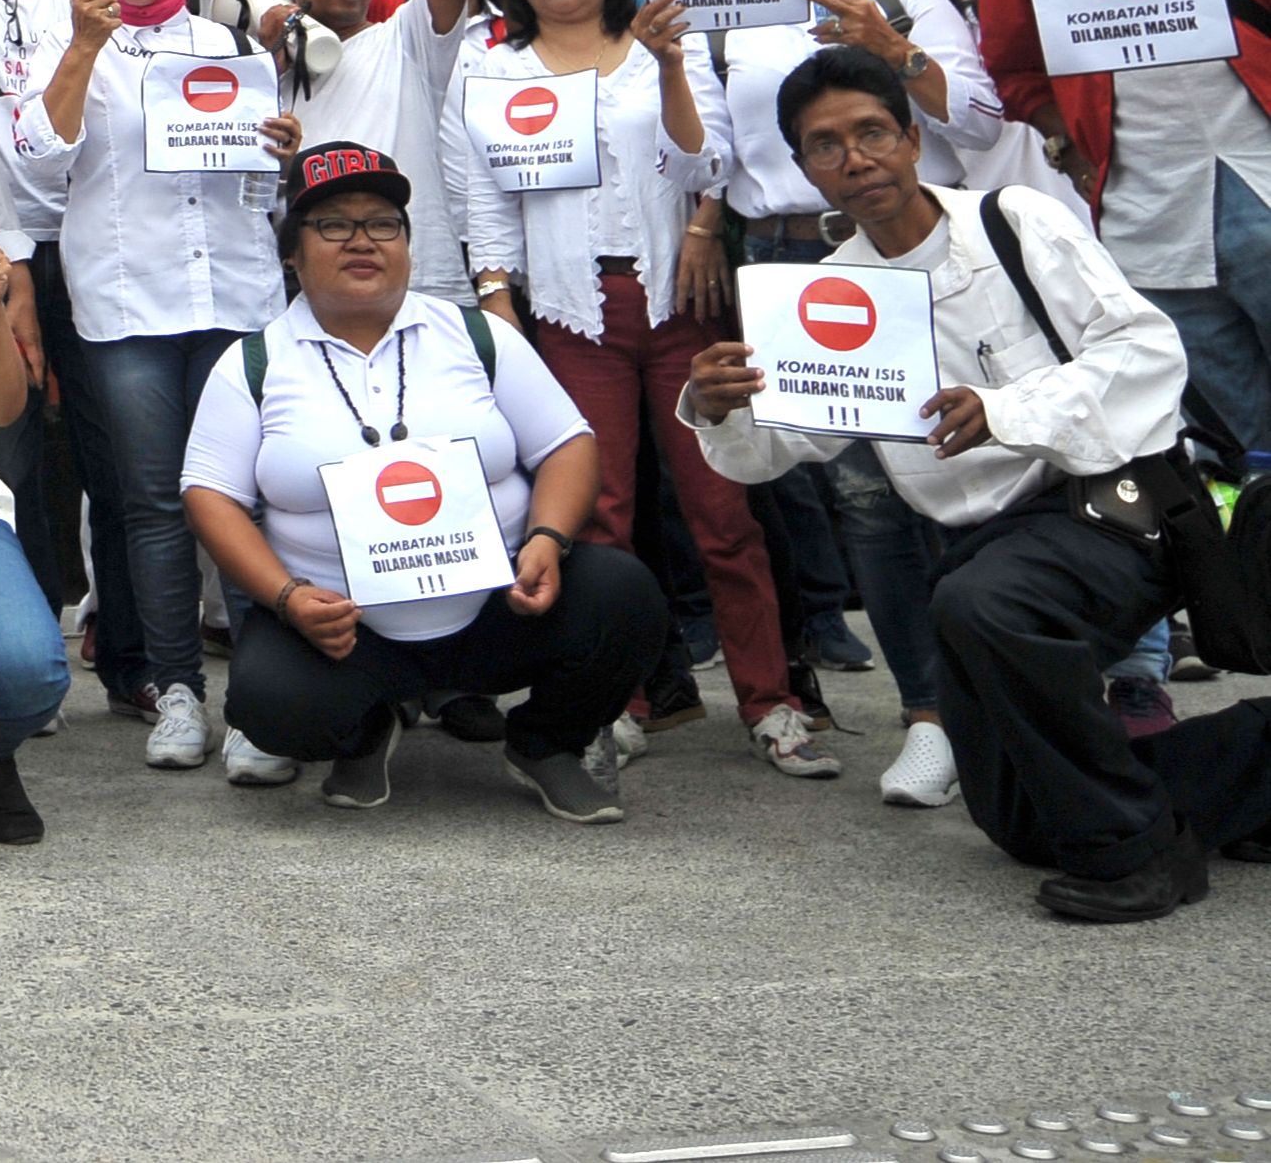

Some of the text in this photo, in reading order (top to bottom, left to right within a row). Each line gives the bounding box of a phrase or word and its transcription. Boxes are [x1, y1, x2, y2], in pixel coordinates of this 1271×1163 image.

[1067, 0, 1195, 25] KOMBATAN ISIS
[1071, 16, 1198, 44] DILARANG MASUK
[167, 122, 259, 133] KOMBATAN ISIS
[168, 135, 258, 147] DILARANG MASUK
[485, 139, 573, 154] KOMBATAN ISIS
[488, 152, 573, 168] DILARANG MASUK
[777, 360, 905, 382] KOMBATAN ISIS
[779, 378, 906, 402] DILARANG MASUK
[369, 531, 474, 555] KOMBATAN ISIS
[372, 547, 479, 574] DILARANG MASUK
